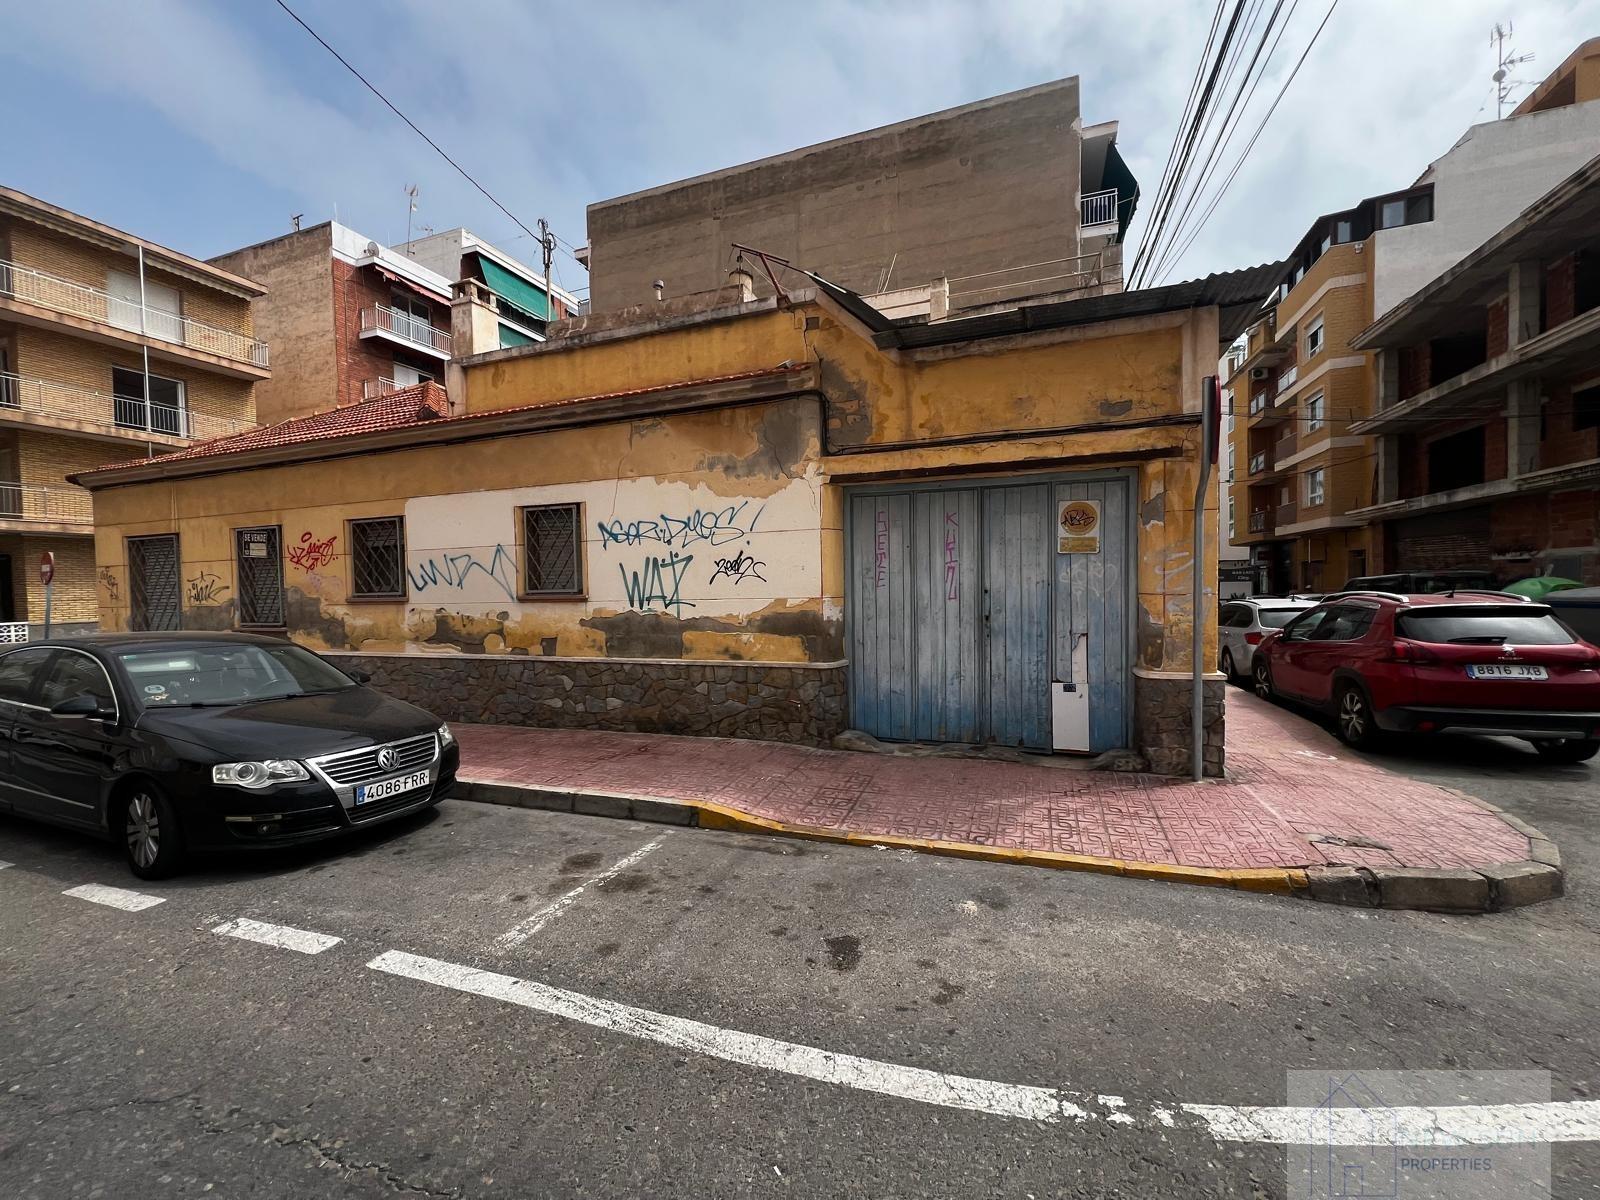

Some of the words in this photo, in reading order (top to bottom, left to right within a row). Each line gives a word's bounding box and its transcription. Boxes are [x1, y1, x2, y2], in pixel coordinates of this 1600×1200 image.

[244, 533, 251, 542] SE
[1476, 665, 1512, 675] 8816
[1518, 665, 1542, 676] JXB
[366, 779, 401, 799] 4086
[403, 772, 426, 790] FRR
